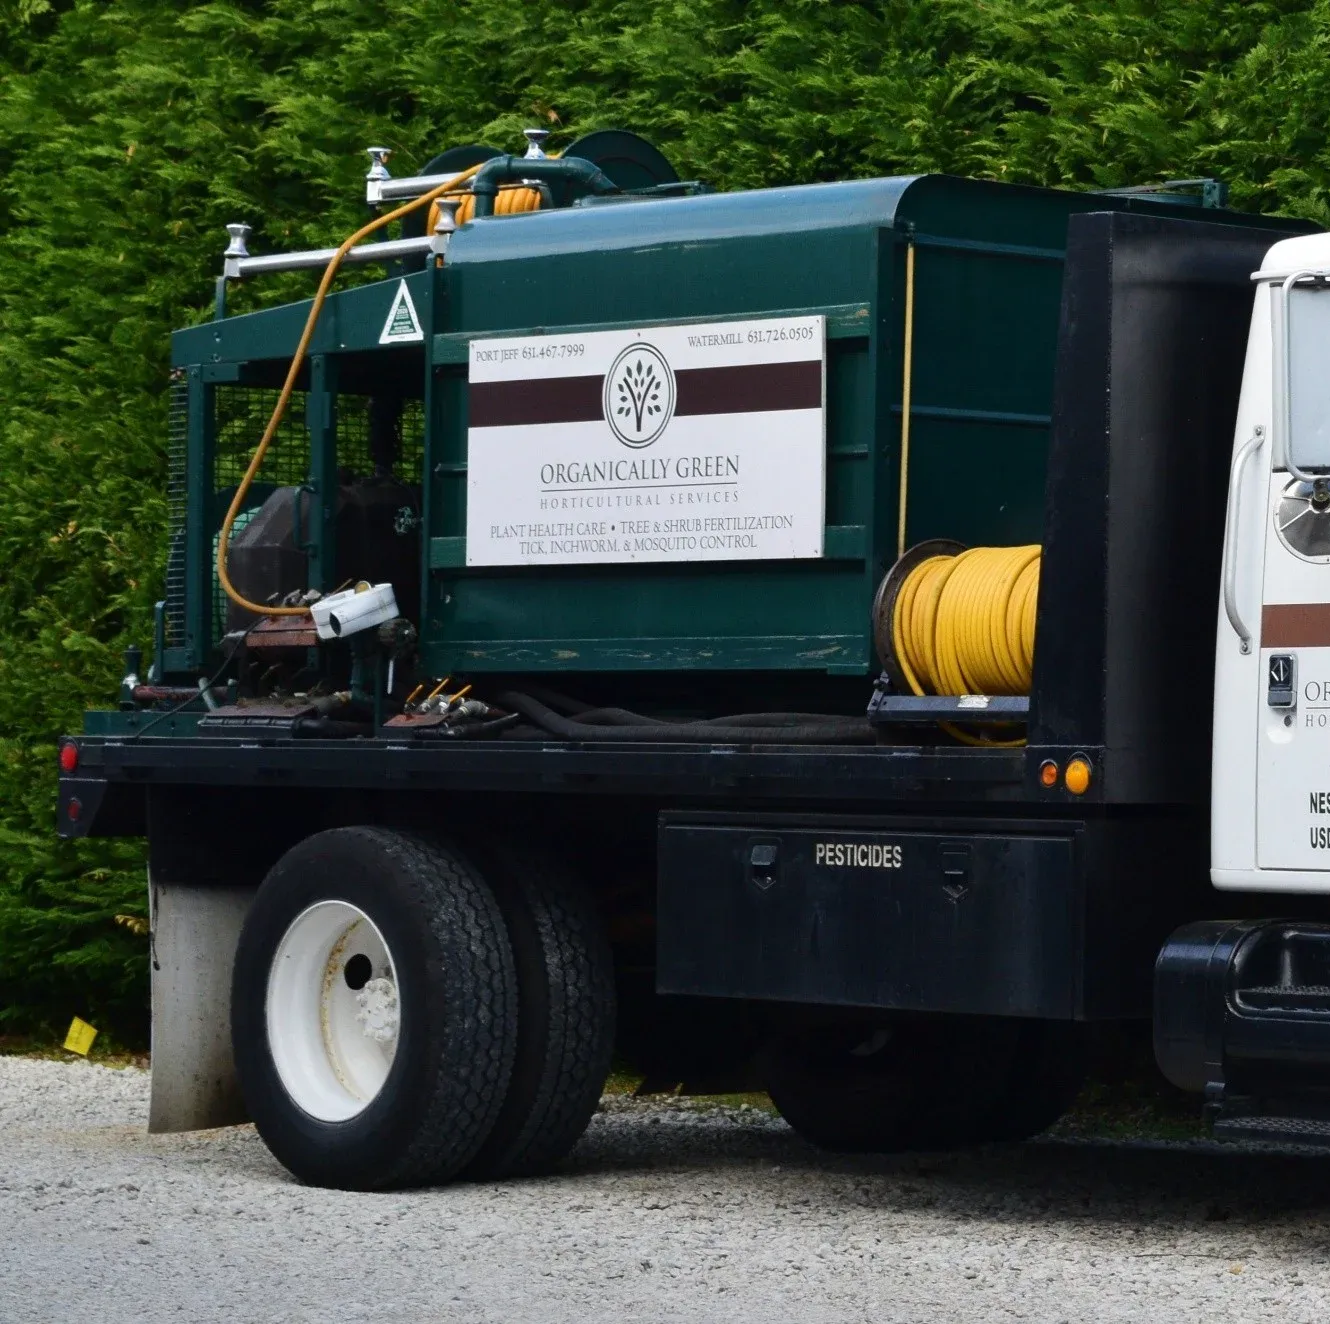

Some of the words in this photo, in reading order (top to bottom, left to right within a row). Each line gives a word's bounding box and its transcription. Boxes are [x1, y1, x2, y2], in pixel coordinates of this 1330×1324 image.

[687, 332, 744, 347] WATERMILL
[747, 327, 814, 344] 631.726.0505
[476, 349, 499, 362] PORT
[500, 348, 519, 363] JEFF
[522, 344, 585, 360] 631.467.7999
[540, 459, 671, 484] ORGANICALLY
[676, 455, 739, 478] GREEN
[540, 494, 661, 509] HORTICULTURAL
[670, 490, 738, 504] SERVICES
[490, 524, 526, 538] PLANT
[528, 523, 574, 537] HEALTH
[576, 522, 606, 536] CARE
[620, 520, 650, 534] TREE
[653, 521, 661, 533] &
[663, 518, 701, 533] SHRUB
[704, 515, 793, 532] FERTILIZATION
[519, 541, 548, 555] TICK,
[623, 540, 631, 552] &
[634, 536, 697, 553] MOSQUITO
[700, 534, 757, 550] CONTROL
[815, 843, 902, 868] PESTICIDES
